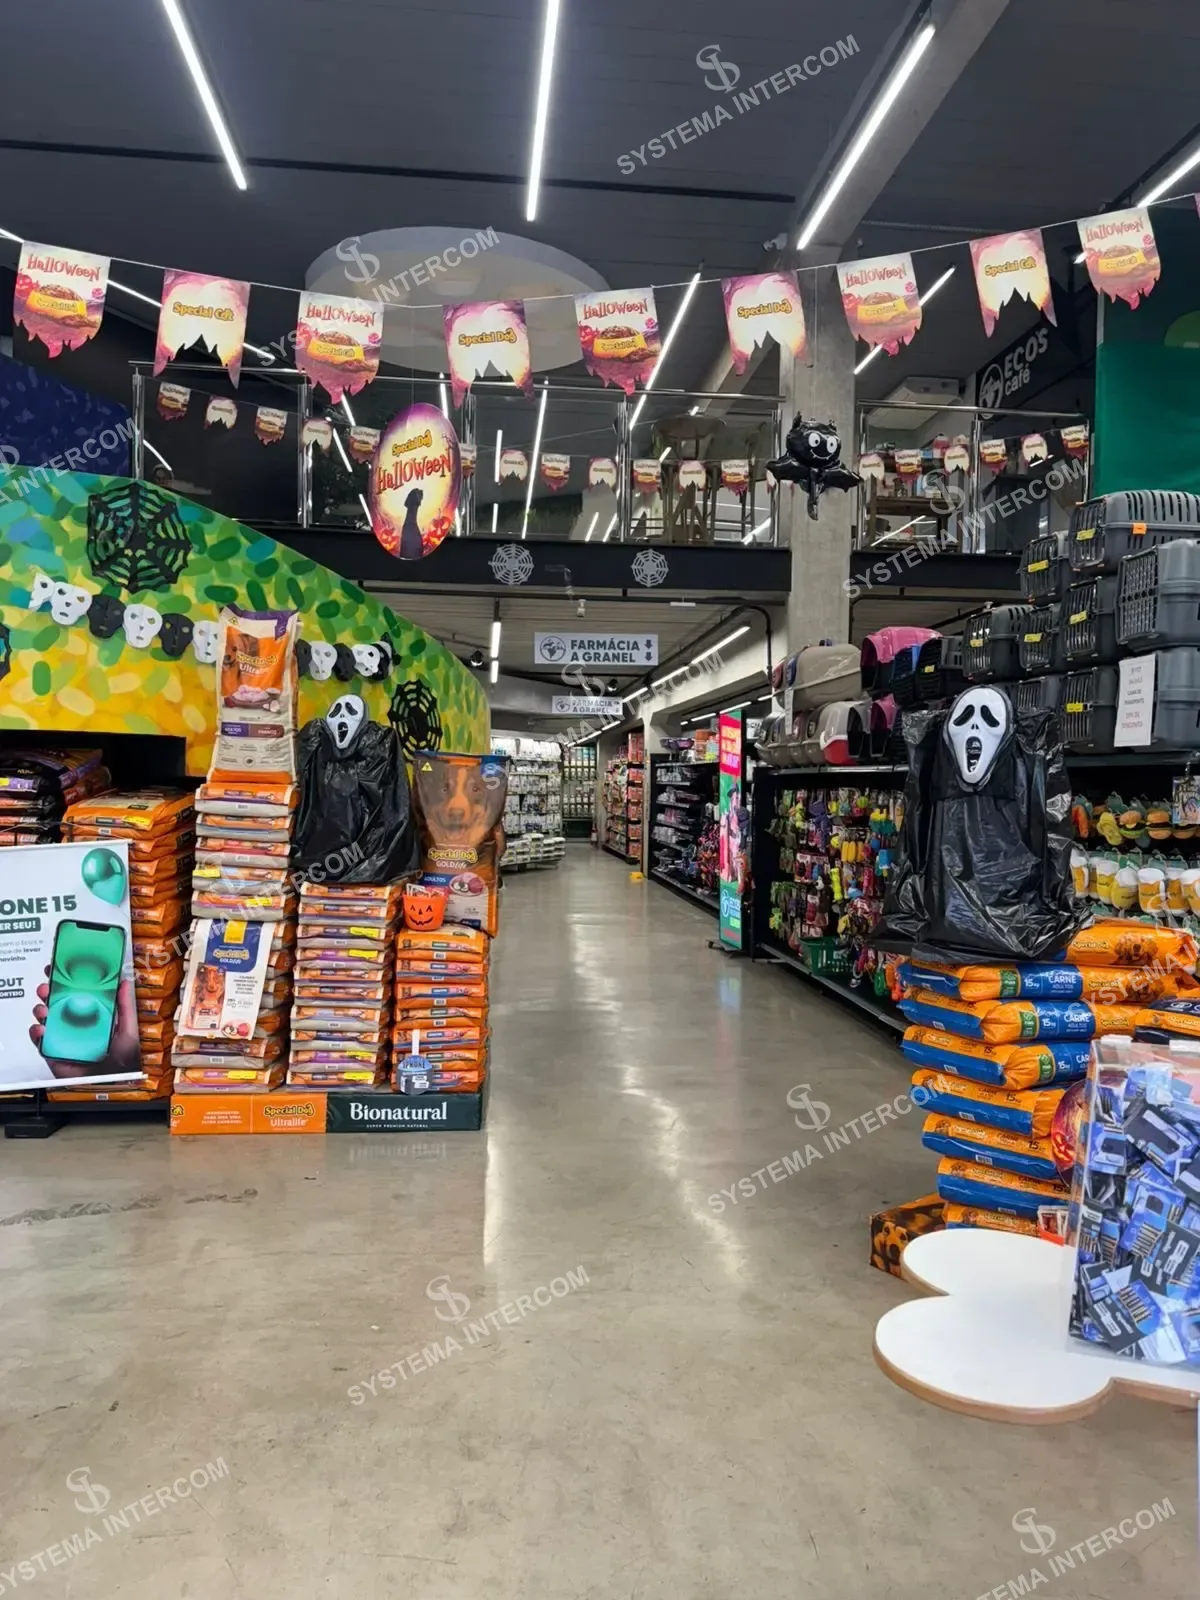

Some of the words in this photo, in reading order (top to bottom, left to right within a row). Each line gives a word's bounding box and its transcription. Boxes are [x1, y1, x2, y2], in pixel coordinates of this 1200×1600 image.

[985, 261, 1020, 277] Special
[173, 301, 213, 318] Special
[737, 303, 772, 319] Special
[773, 297, 793, 314] Dog
[458, 332, 495, 347] Special
[496, 328, 517, 343] Dog
[1004, 363, 1031, 396] café
[392, 435, 421, 457] Special
[419, 429, 433, 448] Dog
[570, 638, 640, 651] FARMÁCIA
[570, 652, 579, 662] A
[582, 652, 636, 663] GRANEL
[239, 663, 270, 675] Ultra
[429, 848, 459, 863] Special
[459, 849, 478, 863] Dog
[52, 895, 77, 912] 15
[13, 920, 37, 930] SEU!
[1048, 974, 1077, 984] CARNE
[1064, 1013, 1090, 1023] CARNE
[1076, 1054, 1090, 1064] CAR
[263, 1105, 297, 1118] Special
[297, 1102, 315, 1117] Dog
[349, 1102, 448, 1121] Bionatural
